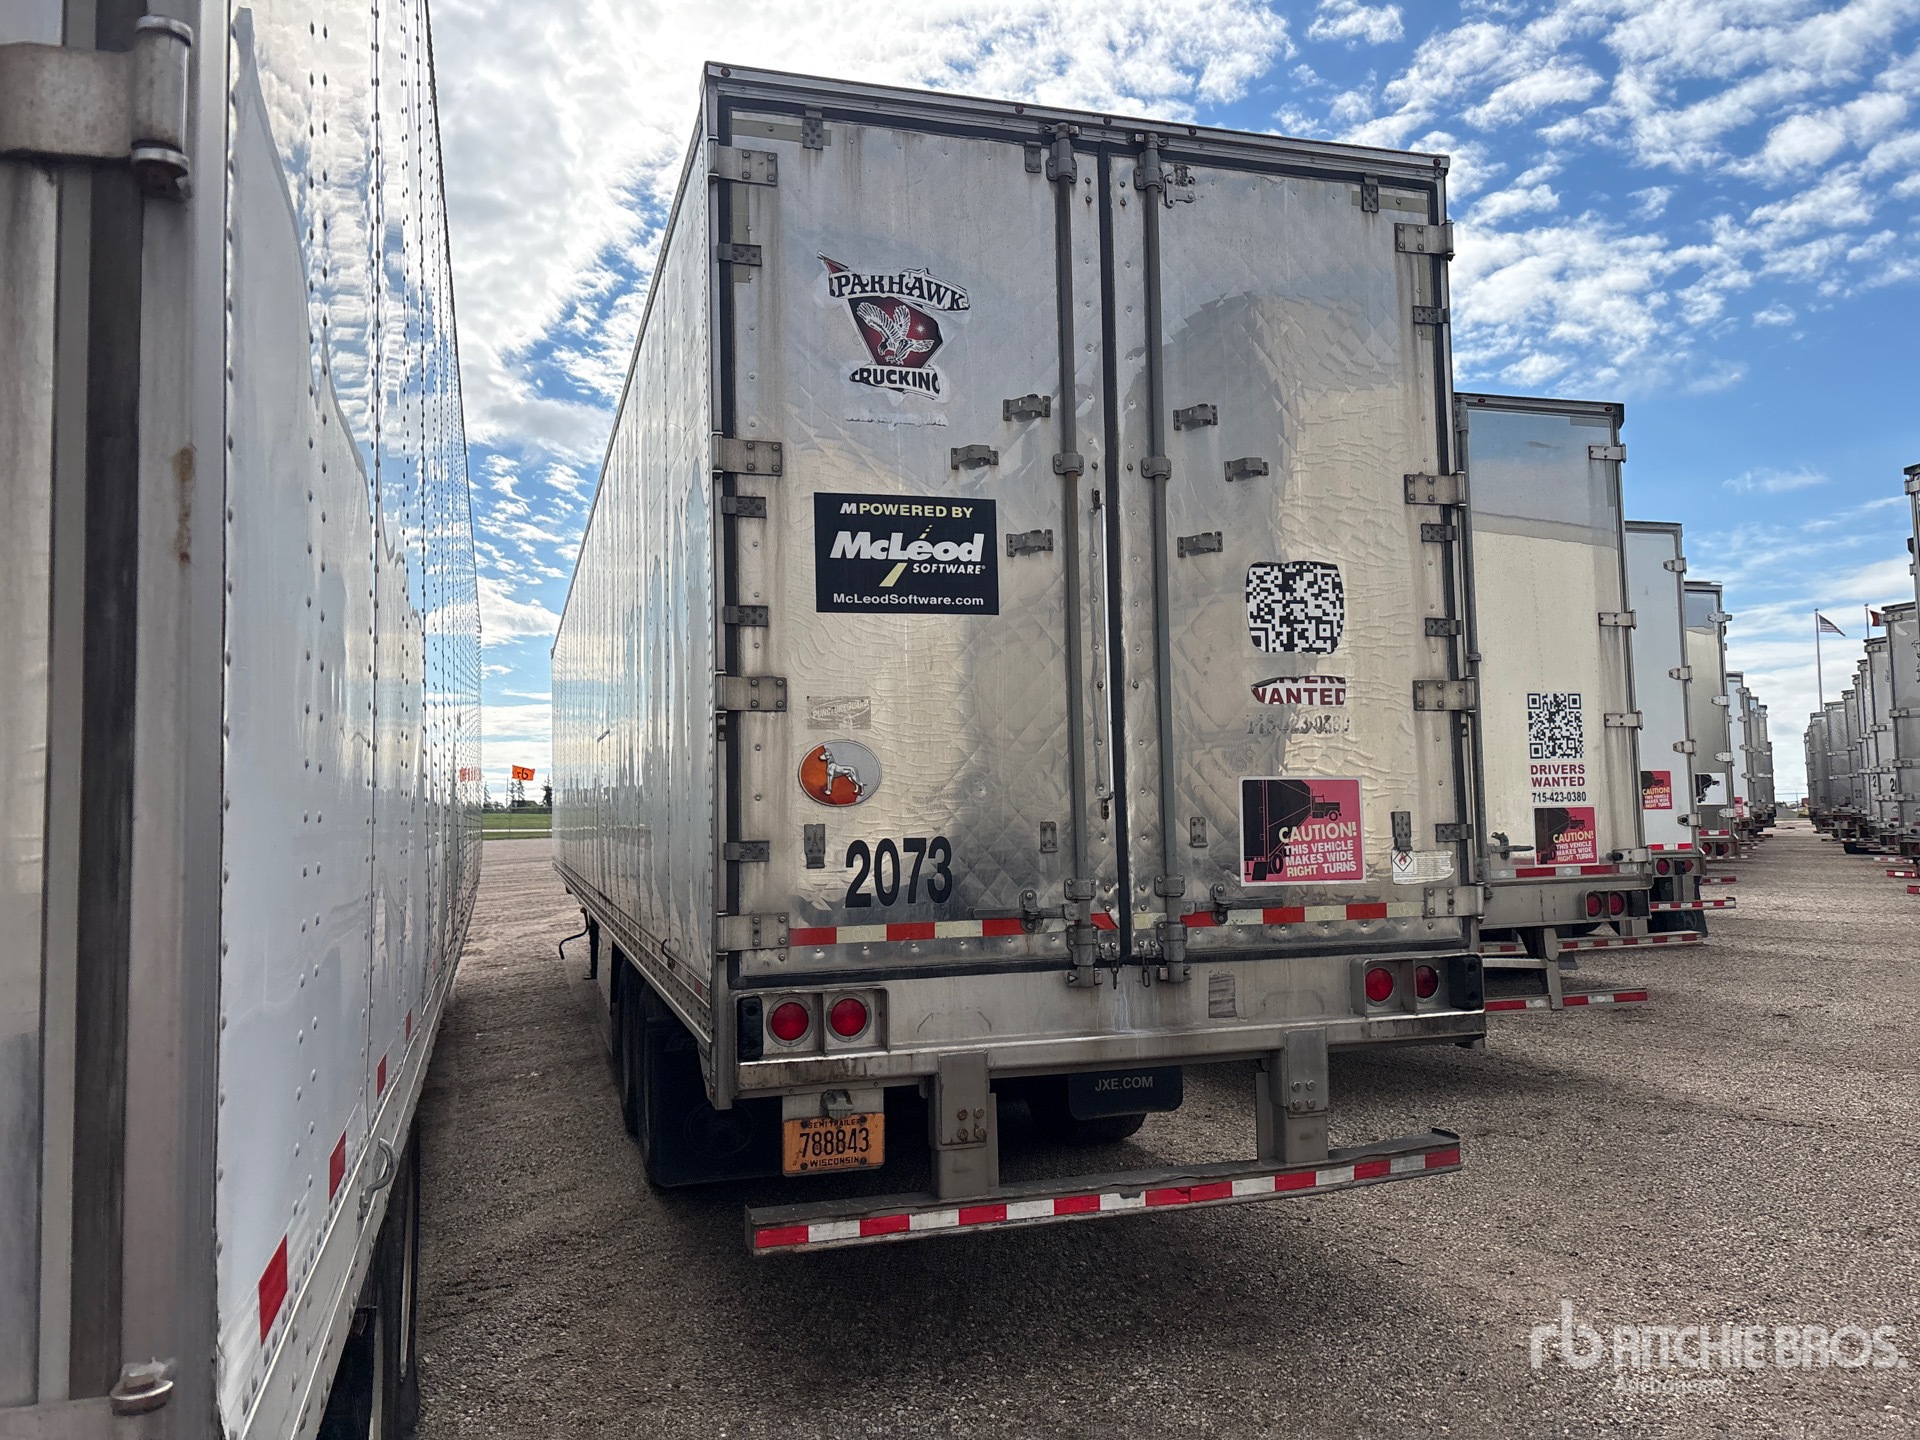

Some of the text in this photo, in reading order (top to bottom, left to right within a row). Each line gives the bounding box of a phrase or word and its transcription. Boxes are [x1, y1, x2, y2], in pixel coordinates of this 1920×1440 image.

[951, 506, 973, 519] BY
[829, 530, 984, 562] McLeod
[833, 593, 984, 606] McLeodSoftware.com
[1530, 764, 1585, 775] DRIVERS
[1531, 777, 1586, 787] WANTED
[1532, 791, 1586, 803] 715-423-0380
[1278, 821, 1358, 844] CAUTION!
[1552, 830, 1594, 844] CAUTION!
[1284, 840, 1354, 856] THIS VEHICLE
[1570, 840, 1592, 848] VEHICLE
[1285, 850, 1354, 867] MAKES WIDE
[845, 836, 952, 908] 2073
[1286, 861, 1357, 878] RIGHT TURNS
[1095, 1076, 1154, 1092] JXE.COM
[799, 1127, 870, 1158] 788843
[810, 1156, 860, 1168] WISCONSIN
